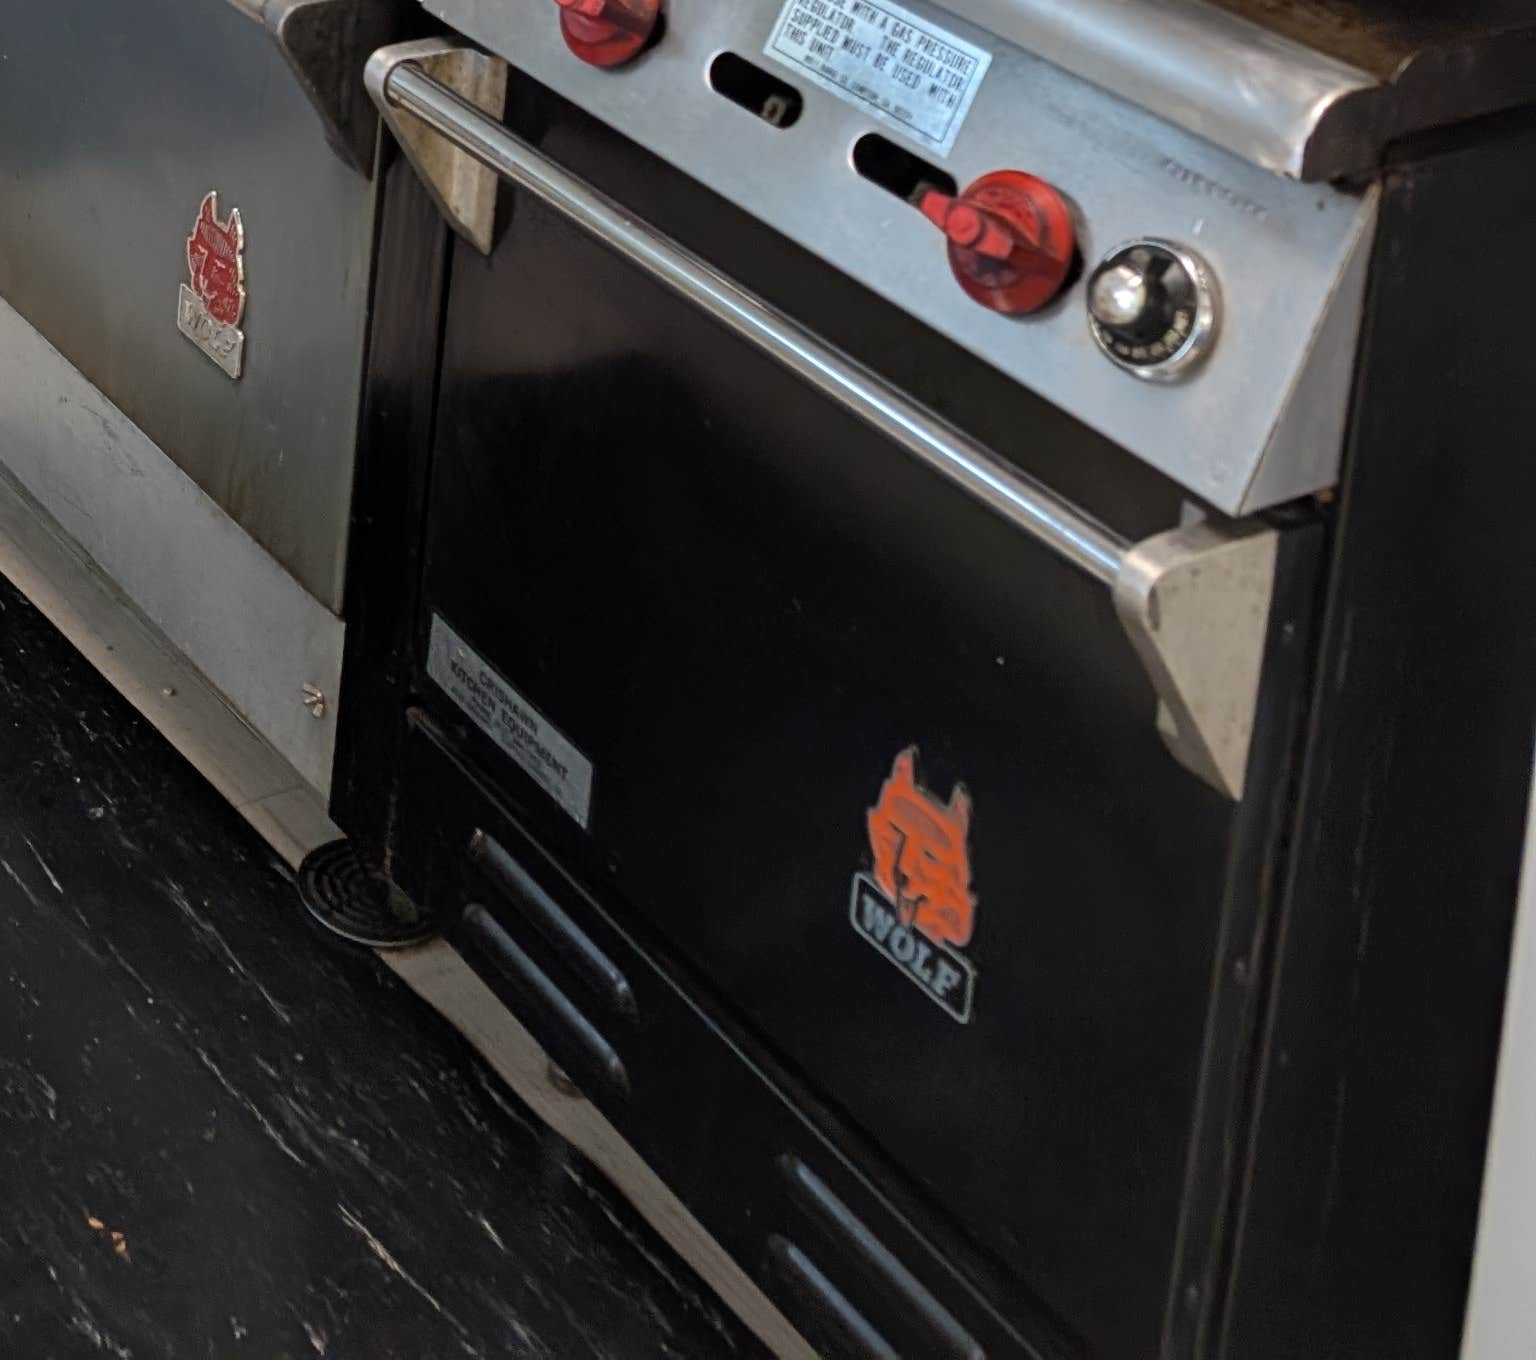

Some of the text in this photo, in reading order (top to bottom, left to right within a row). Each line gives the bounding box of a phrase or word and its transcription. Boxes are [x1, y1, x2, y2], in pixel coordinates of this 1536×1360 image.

[785, 24, 807, 44] THIS
[881, 36, 901, 57] THE
[842, 36, 872, 61] MUST
[892, 64, 921, 90] USED
[863, 894, 962, 997] WOLF
